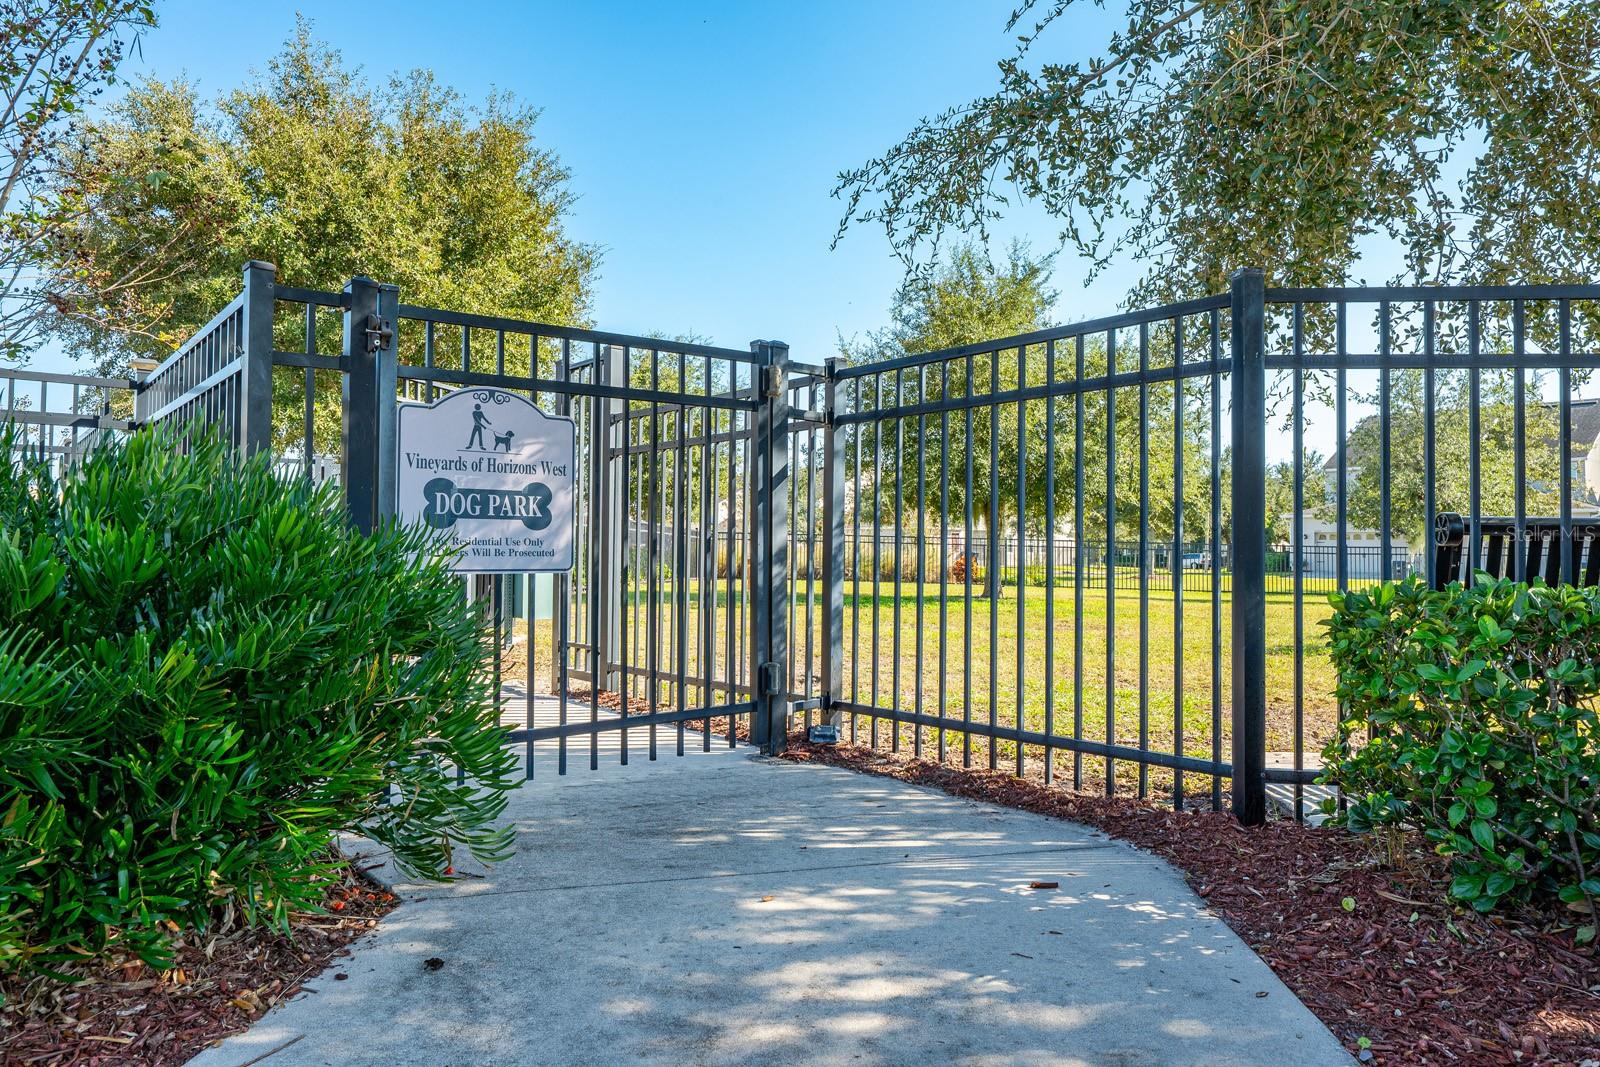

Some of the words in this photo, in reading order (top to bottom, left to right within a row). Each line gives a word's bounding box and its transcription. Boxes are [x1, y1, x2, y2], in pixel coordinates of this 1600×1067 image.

[406, 453, 467, 474] Vineyards
[471, 459, 484, 473] of
[487, 458, 537, 475] Horizons
[540, 461, 567, 477] West
[435, 492, 481, 516] DOG
[487, 495, 543, 517] PARK
[452, 537, 502, 546] Residential
[505, 538, 521, 547] Use
[523, 538, 545, 547] Only
[472, 548, 491, 557] Will
[494, 549, 506, 557] Be
[508, 548, 555, 557] Prosecuted
